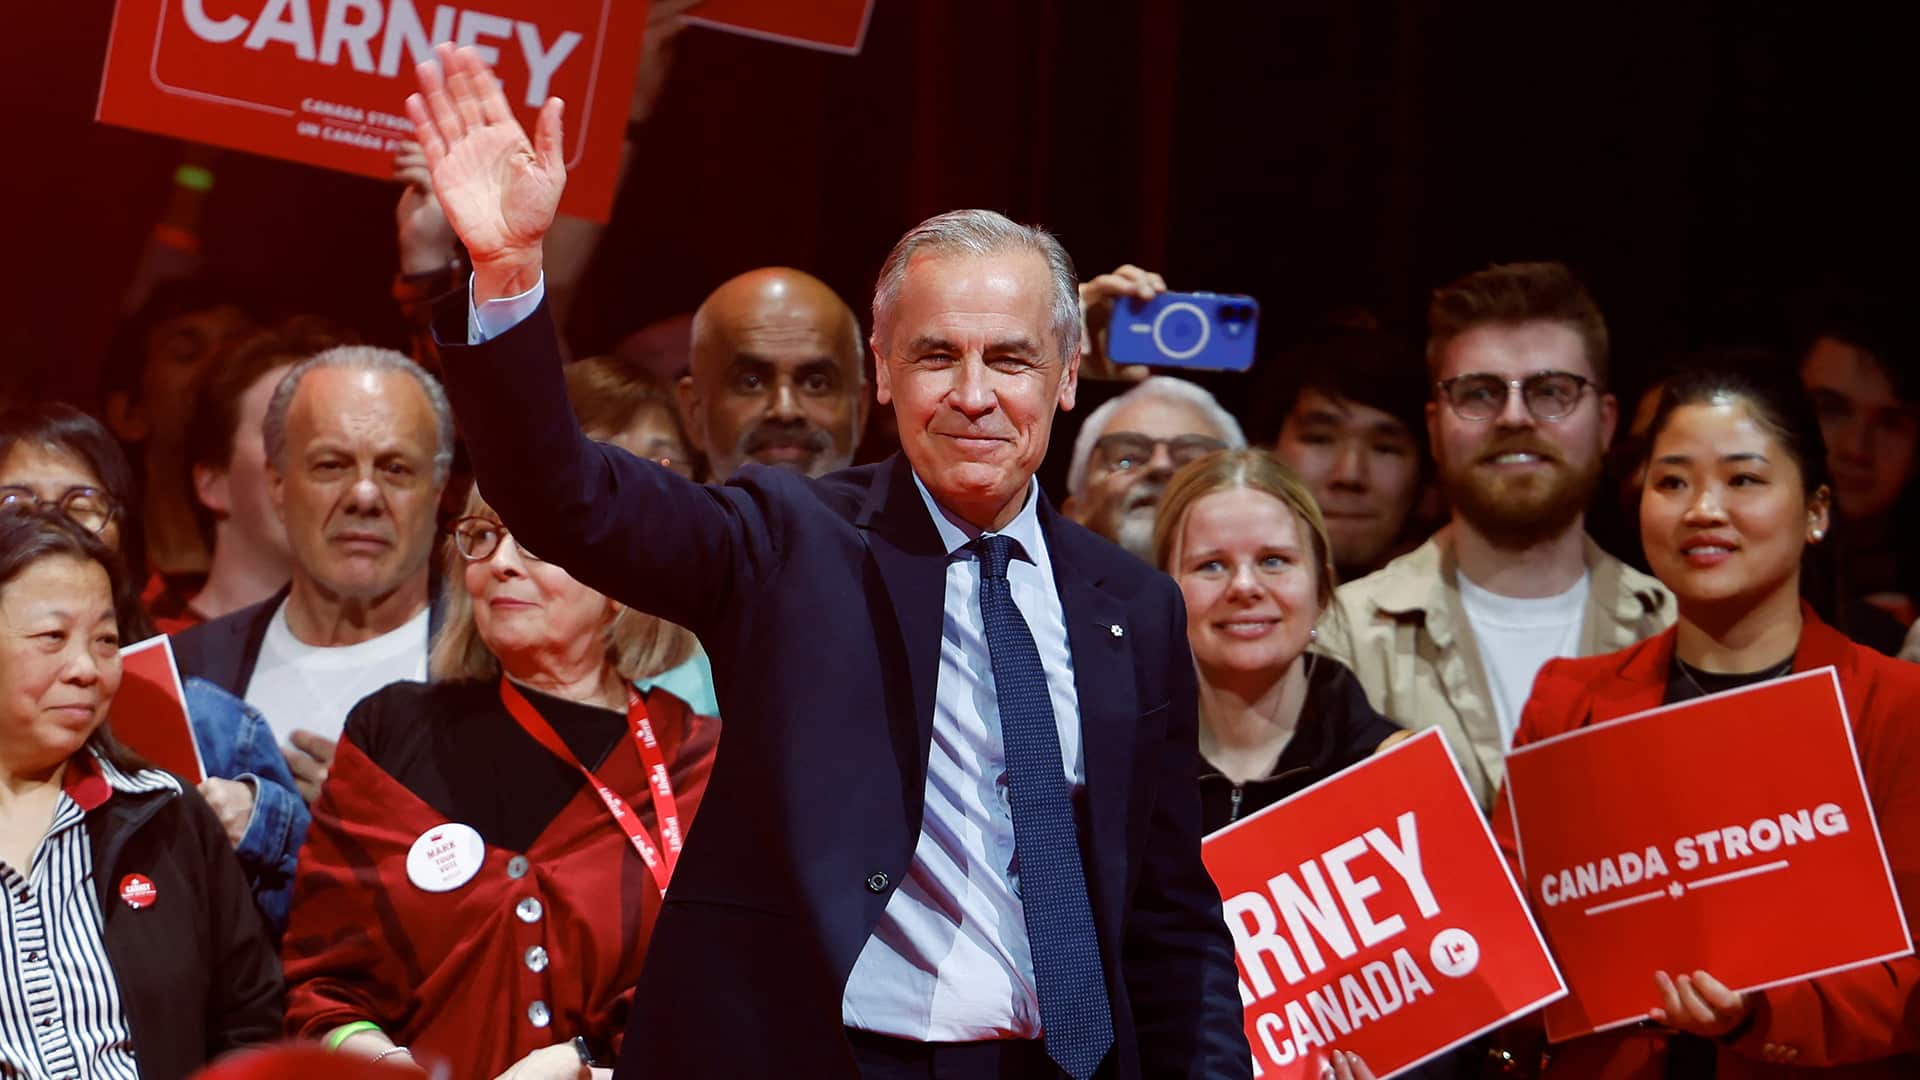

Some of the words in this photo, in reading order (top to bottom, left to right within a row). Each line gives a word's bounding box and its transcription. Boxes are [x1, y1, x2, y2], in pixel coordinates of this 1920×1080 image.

[297, 121, 320, 137] UN
[321, 126, 382, 150] CANADA
[301, 97, 365, 121] CANADA
[1541, 846, 1669, 906] CANADA
[1674, 803, 1849, 870] STRONG
[1222, 811, 1441, 1007] RNEY
[1255, 947, 1435, 1067] CANADA
